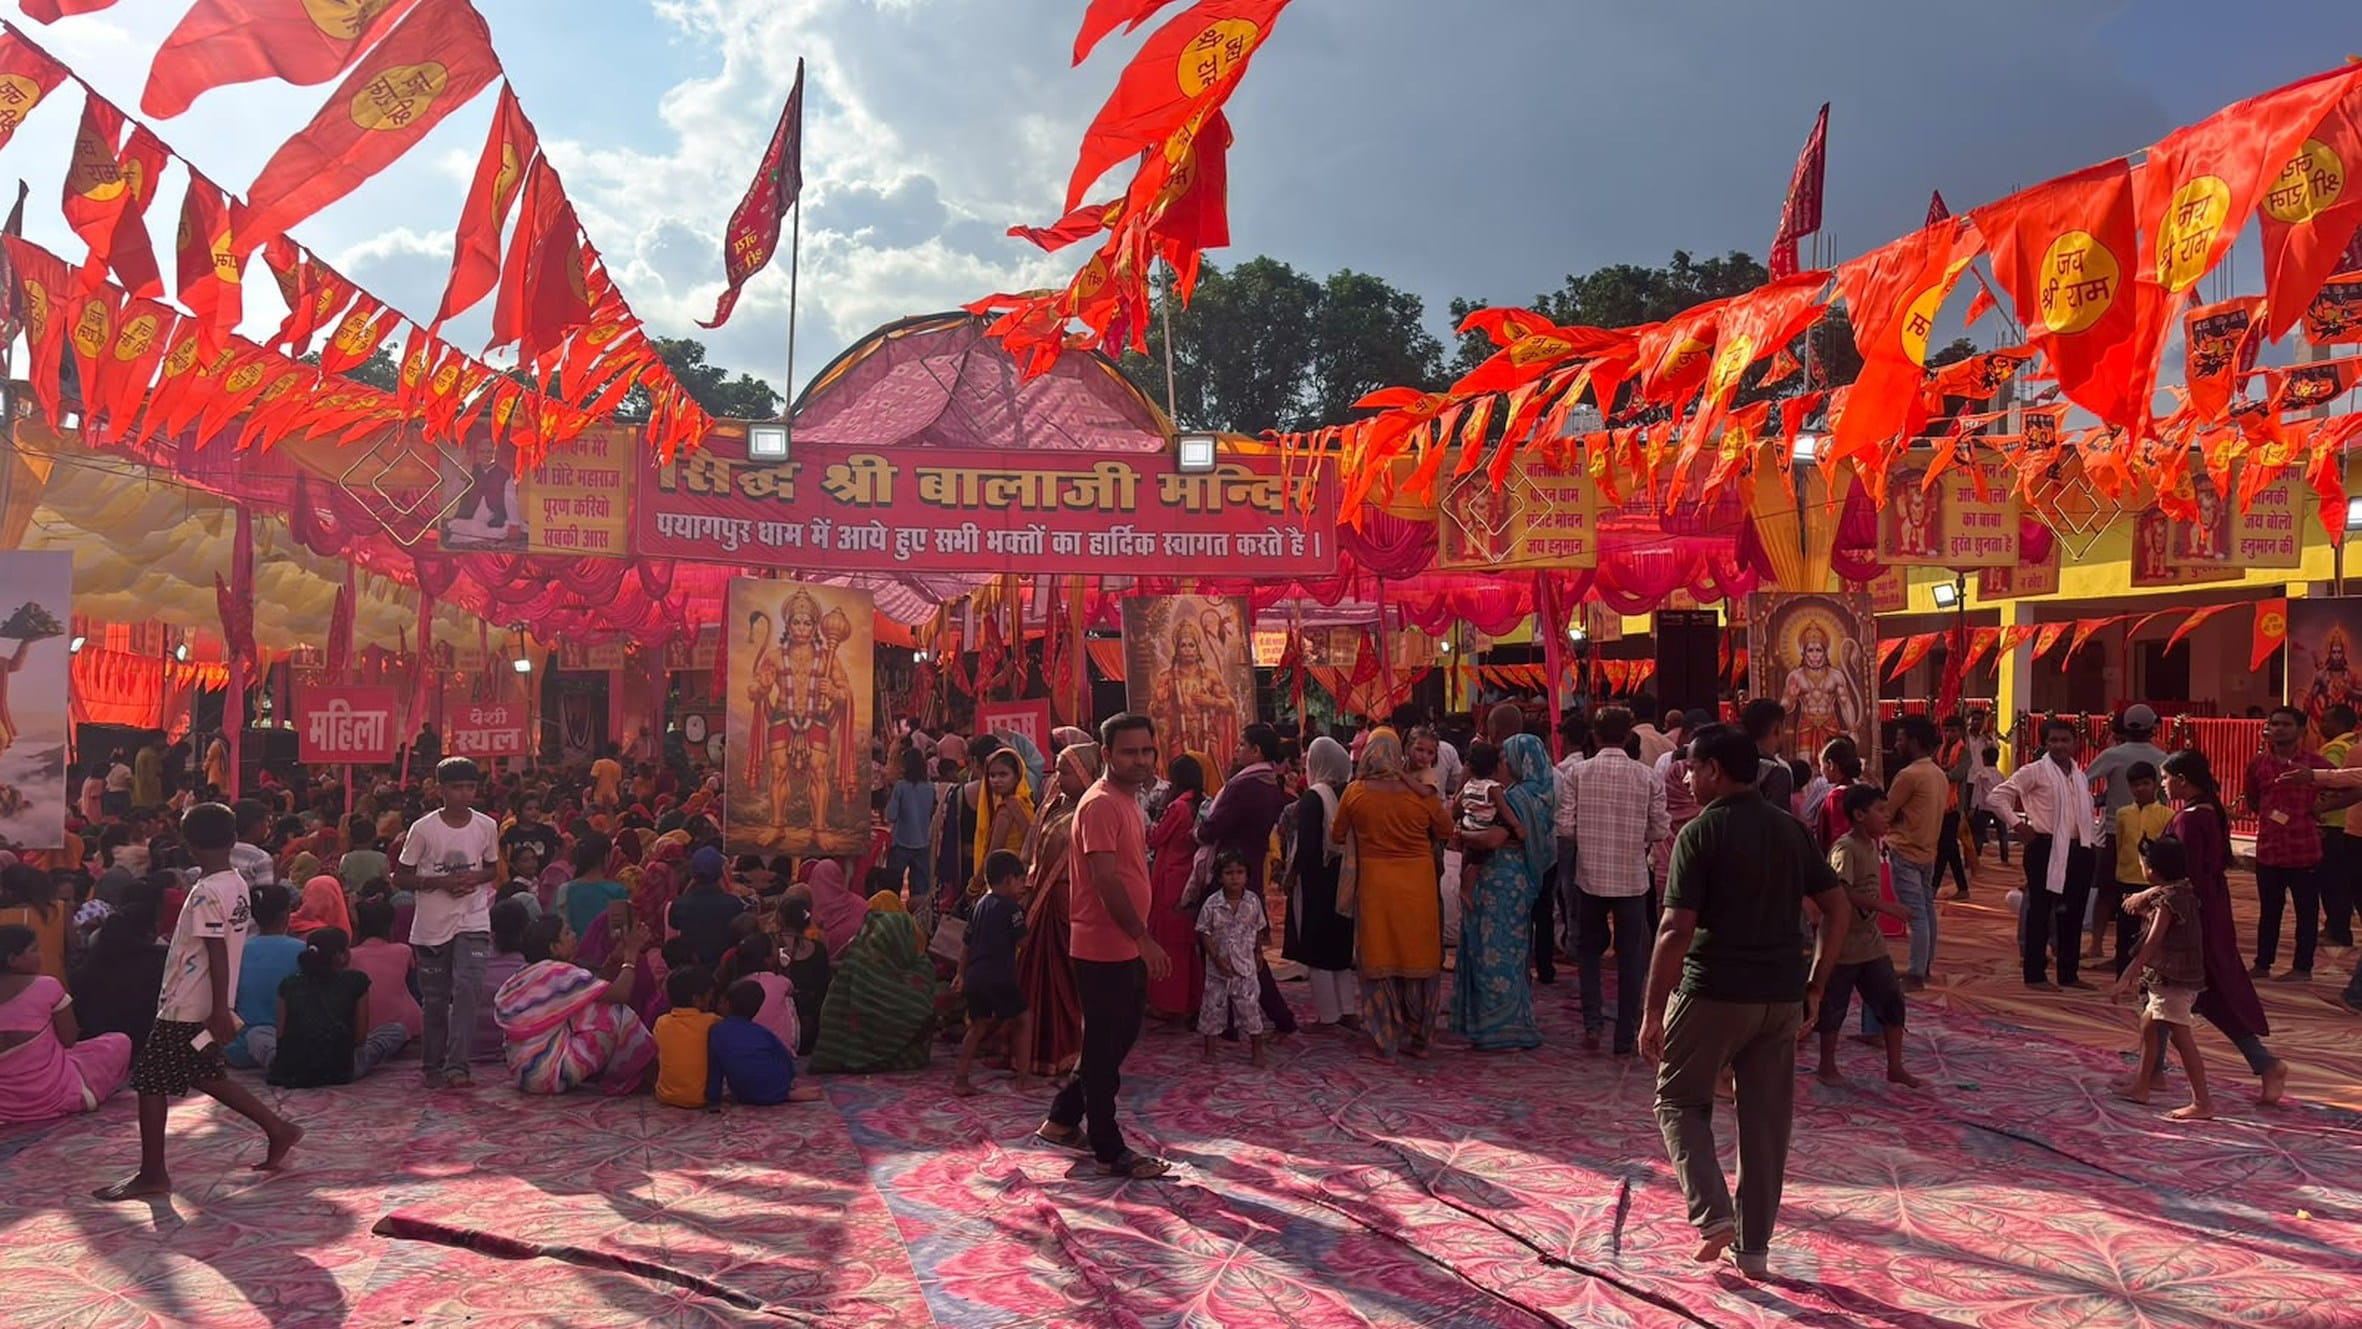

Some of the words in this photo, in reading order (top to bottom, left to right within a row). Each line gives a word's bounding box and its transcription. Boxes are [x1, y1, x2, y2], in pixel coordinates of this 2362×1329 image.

[2057, 248, 2086, 276] जय
[2042, 276, 2060, 310] श्री
[2065, 275, 2110, 308] राम
[551, 462, 573, 487] छोटे
[577, 468, 620, 489] महाराज
[820, 453, 898, 505] श्री
[916, 460, 1142, 512] बालाजी
[1157, 463, 1317, 514] मन्दिर
[1559, 487, 1580, 503] धाम
[543, 498, 571, 524] पूरण
[573, 495, 610, 519] करियो
[1555, 509, 1583, 529] मोचन
[1962, 512, 1976, 528] का
[1979, 512, 2002, 528] बाबा
[2244, 513, 2263, 529] जय
[2266, 511, 2292, 530] बोलो
[543, 523, 579, 548] सबकी
[582, 529, 609, 549] आस
[656, 512, 753, 551] पयागपुर
[758, 521, 804, 548] धाम
[811, 517, 833, 549] में
[837, 519, 889, 551] आये
[894, 528, 928, 560] हुए
[934, 522, 980, 554] सभी
[985, 523, 1046, 555] भक्तों
[1050, 530, 1083, 556] का
[1088, 525, 1157, 557] हार्दिक
[1162, 531, 1229, 557] स्वागत
[1235, 526, 1284, 557] करते
[1284, 526, 1306, 557] है
[1526, 538, 1545, 554] जय
[1548, 538, 1584, 559] हनुमान
[1951, 532, 1972, 558] तुरंत
[1975, 536, 2001, 558] सुनता
[2240, 537, 2275, 559] हनुमान
[2278, 535, 2293, 555] की
[308, 698, 388, 752] महिला
[470, 707, 509, 726] पेशी
[455, 728, 522, 752] स्थल
